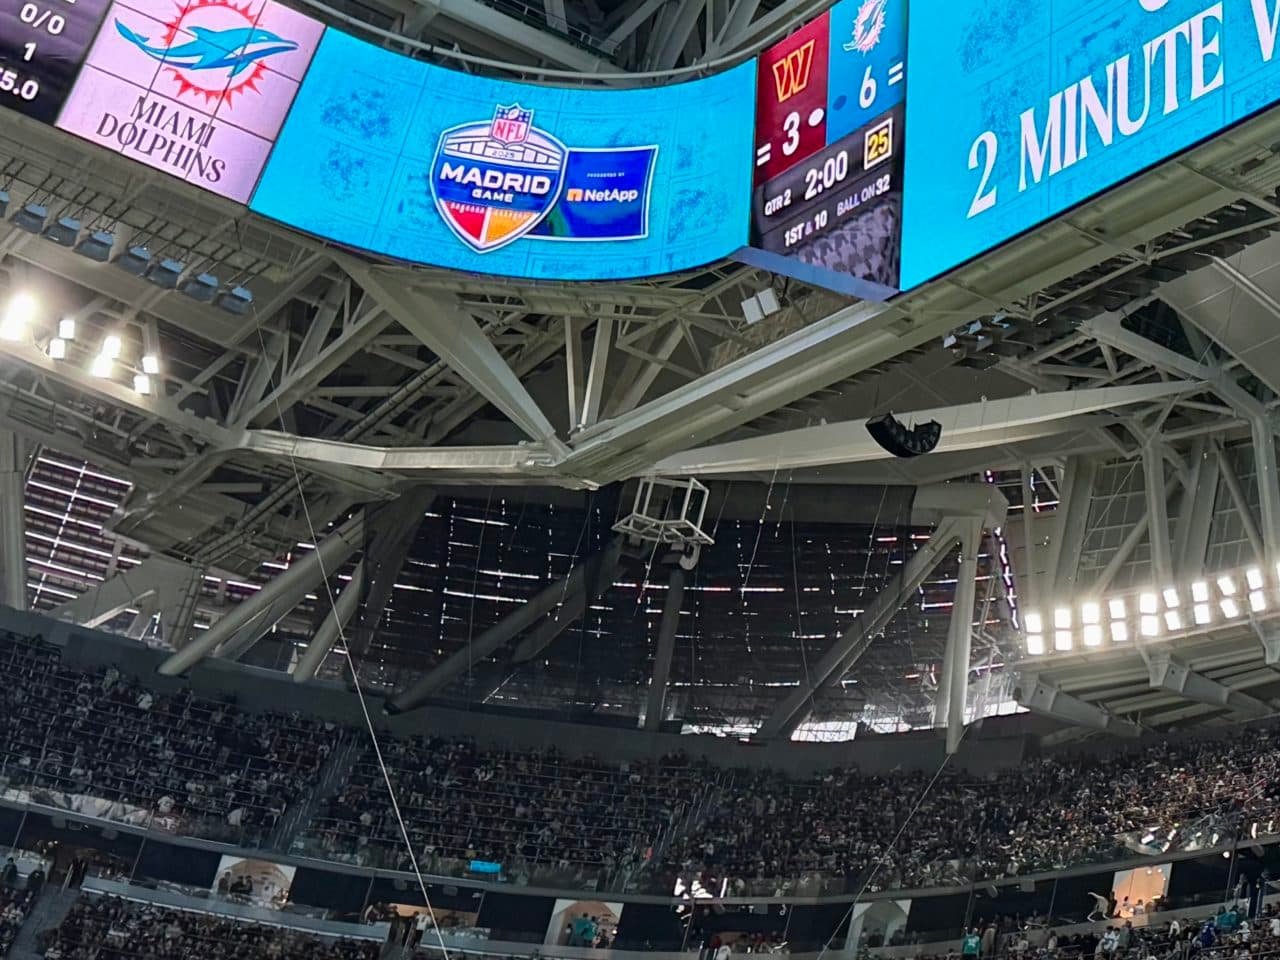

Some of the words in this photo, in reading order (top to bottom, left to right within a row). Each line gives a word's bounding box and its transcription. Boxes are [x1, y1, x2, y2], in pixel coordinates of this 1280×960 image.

[20, 3, 65, 35] 0/0
[23, 42, 37, 61] 1
[0, 66, 39, 100] 5.0
[859, 66, 877, 109] 6
[130, 95, 216, 148] MIAMI
[967, 131, 998, 219] 2
[1018, 2, 1226, 194] MINUTE
[96, 112, 226, 183] DOLPHINS
[495, 121, 525, 140] NFL
[782, 112, 800, 156] 3
[867, 128, 889, 160] 25
[440, 161, 551, 195] MADRID
[764, 194, 784, 217] QTR
[783, 189, 792, 207] 2
[804, 150, 849, 201] 2:00
[472, 188, 514, 203] GAME
[584, 188, 638, 203] NetApp
[784, 222, 805, 248] 1ST
[814, 208, 828, 231] 10
[836, 193, 860, 217] BALL
[860, 182, 876, 203] ON
[875, 173, 891, 197] 32
